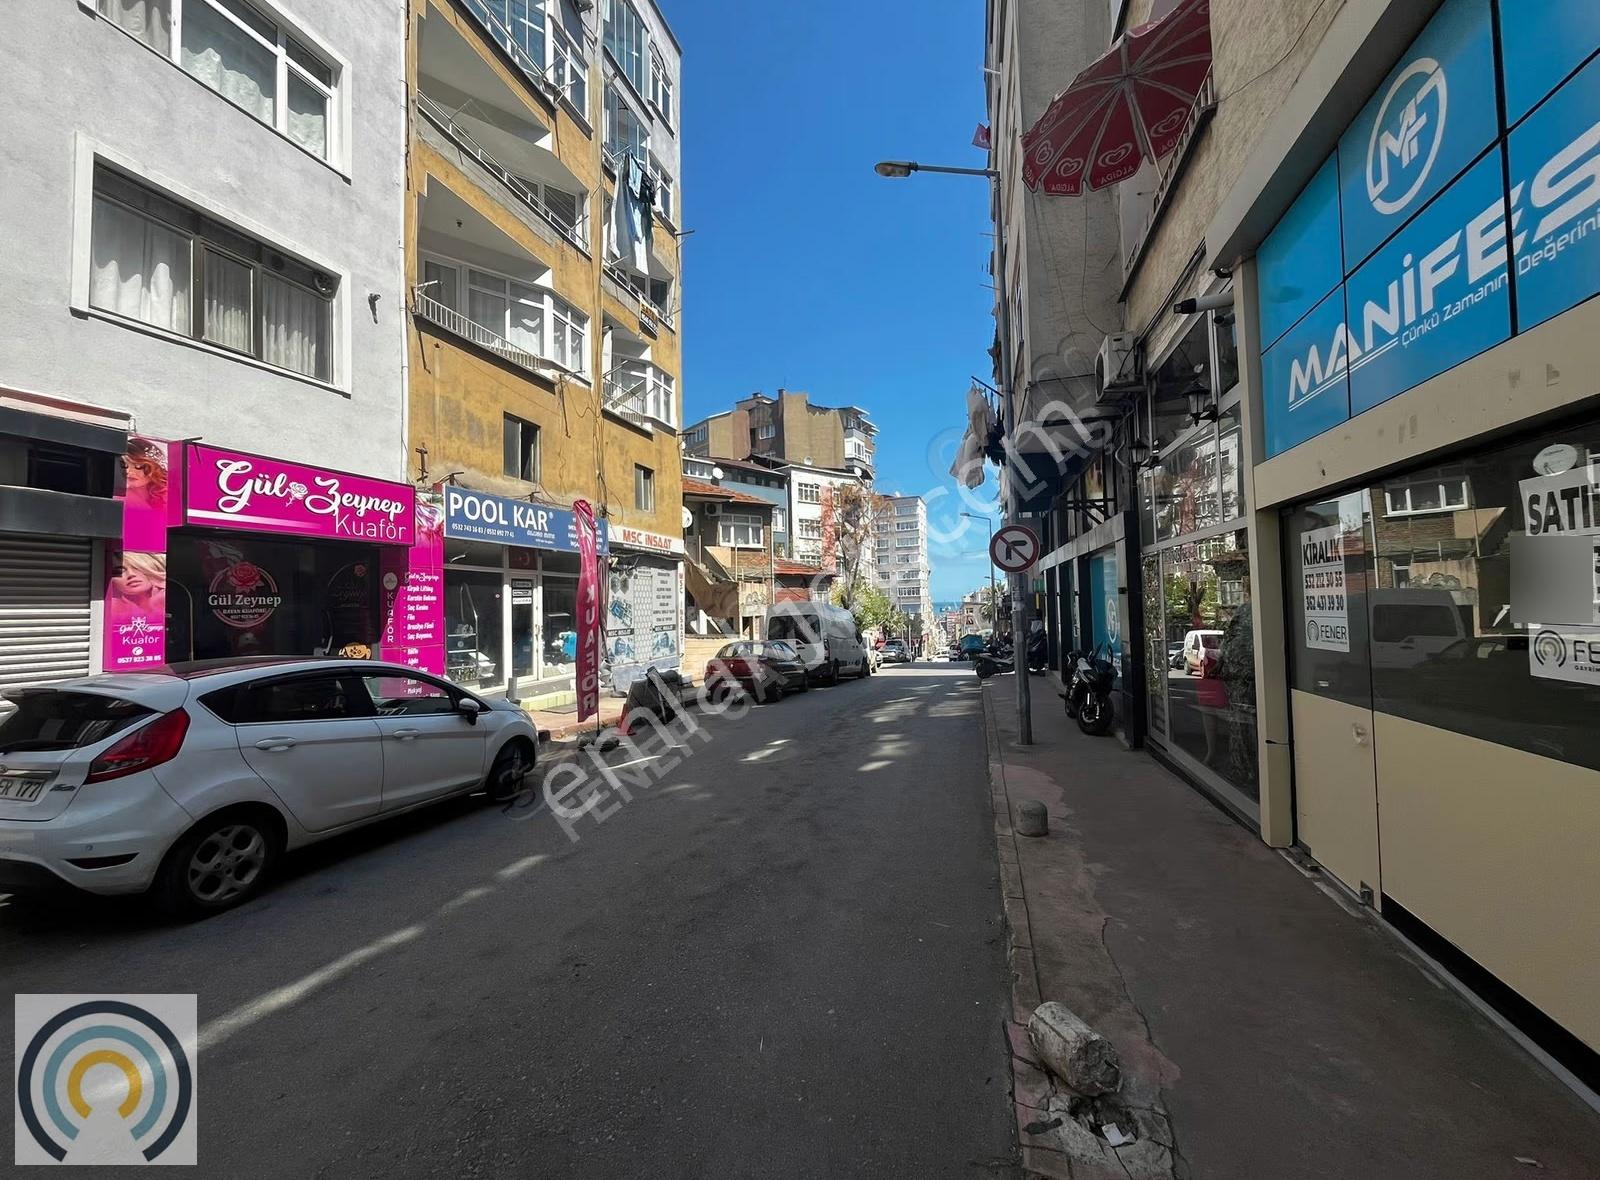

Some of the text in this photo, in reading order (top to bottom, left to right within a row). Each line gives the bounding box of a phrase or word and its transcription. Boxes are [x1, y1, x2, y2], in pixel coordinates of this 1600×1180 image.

[1401, 316, 1440, 349] Çünkü
[1443, 271, 1508, 321] Zamanın
[216, 459, 405, 521] Gül Zeynep
[449, 492, 548, 532] POOL KAR
[335, 513, 406, 540] Kuaför
[623, 529, 642, 544] MSC
[1303, 536, 1342, 566] KİRALIK
[208, 594, 281, 608] Gül Zeynep
[122, 635, 160, 645] Kuaför
[1320, 624, 1347, 640] FENER
